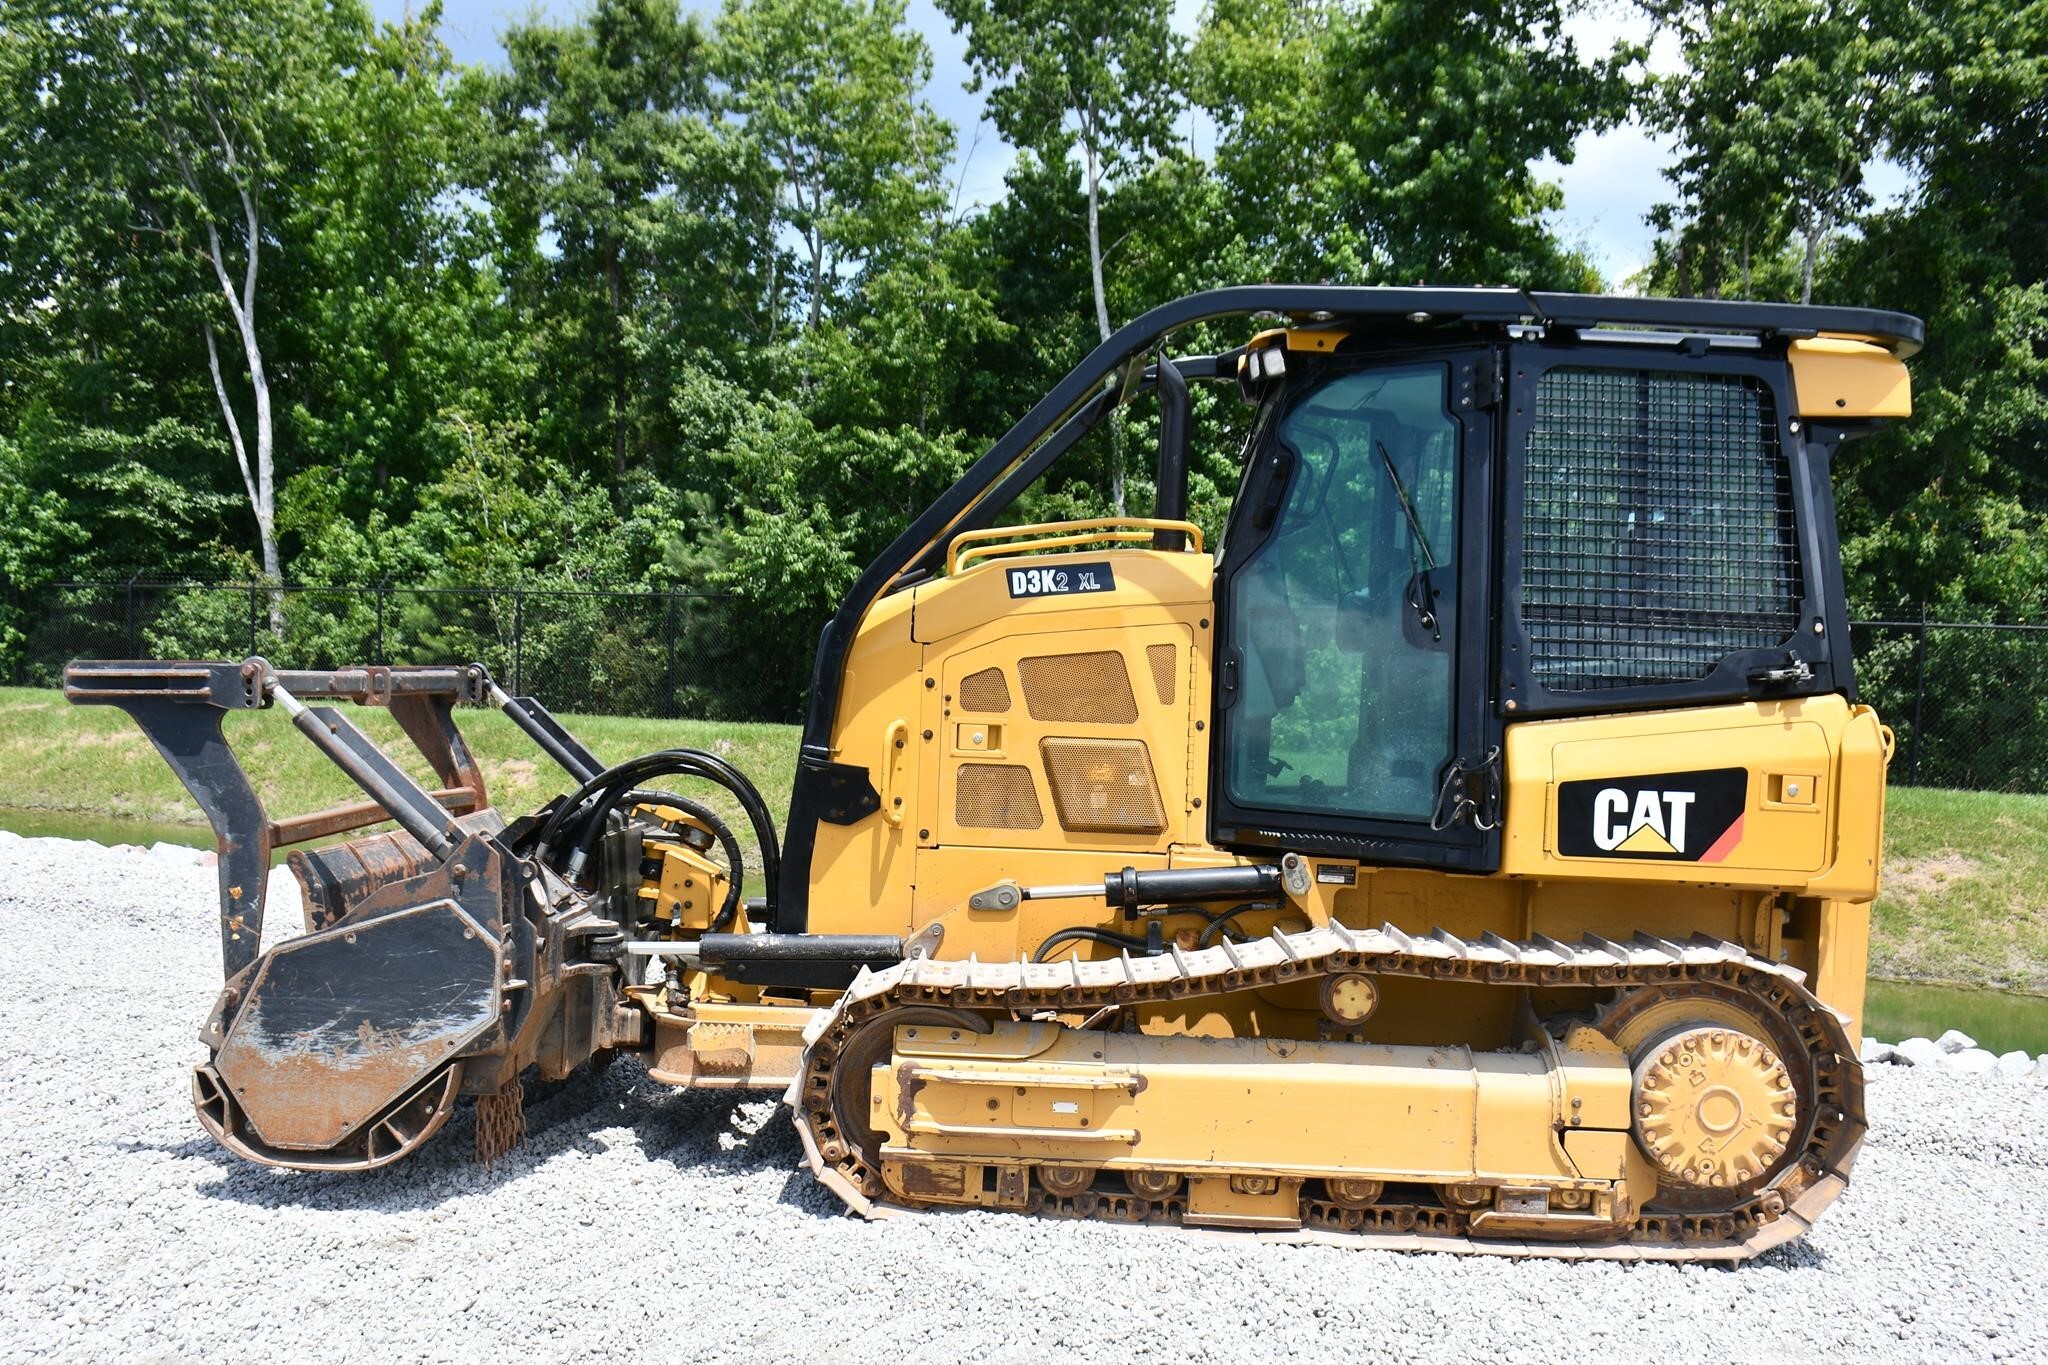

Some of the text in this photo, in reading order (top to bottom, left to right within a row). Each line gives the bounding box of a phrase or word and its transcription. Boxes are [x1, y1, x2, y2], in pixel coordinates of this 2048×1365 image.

[1012, 569, 1101, 595] D3K2 XL
[1593, 788, 1696, 853] CAT
